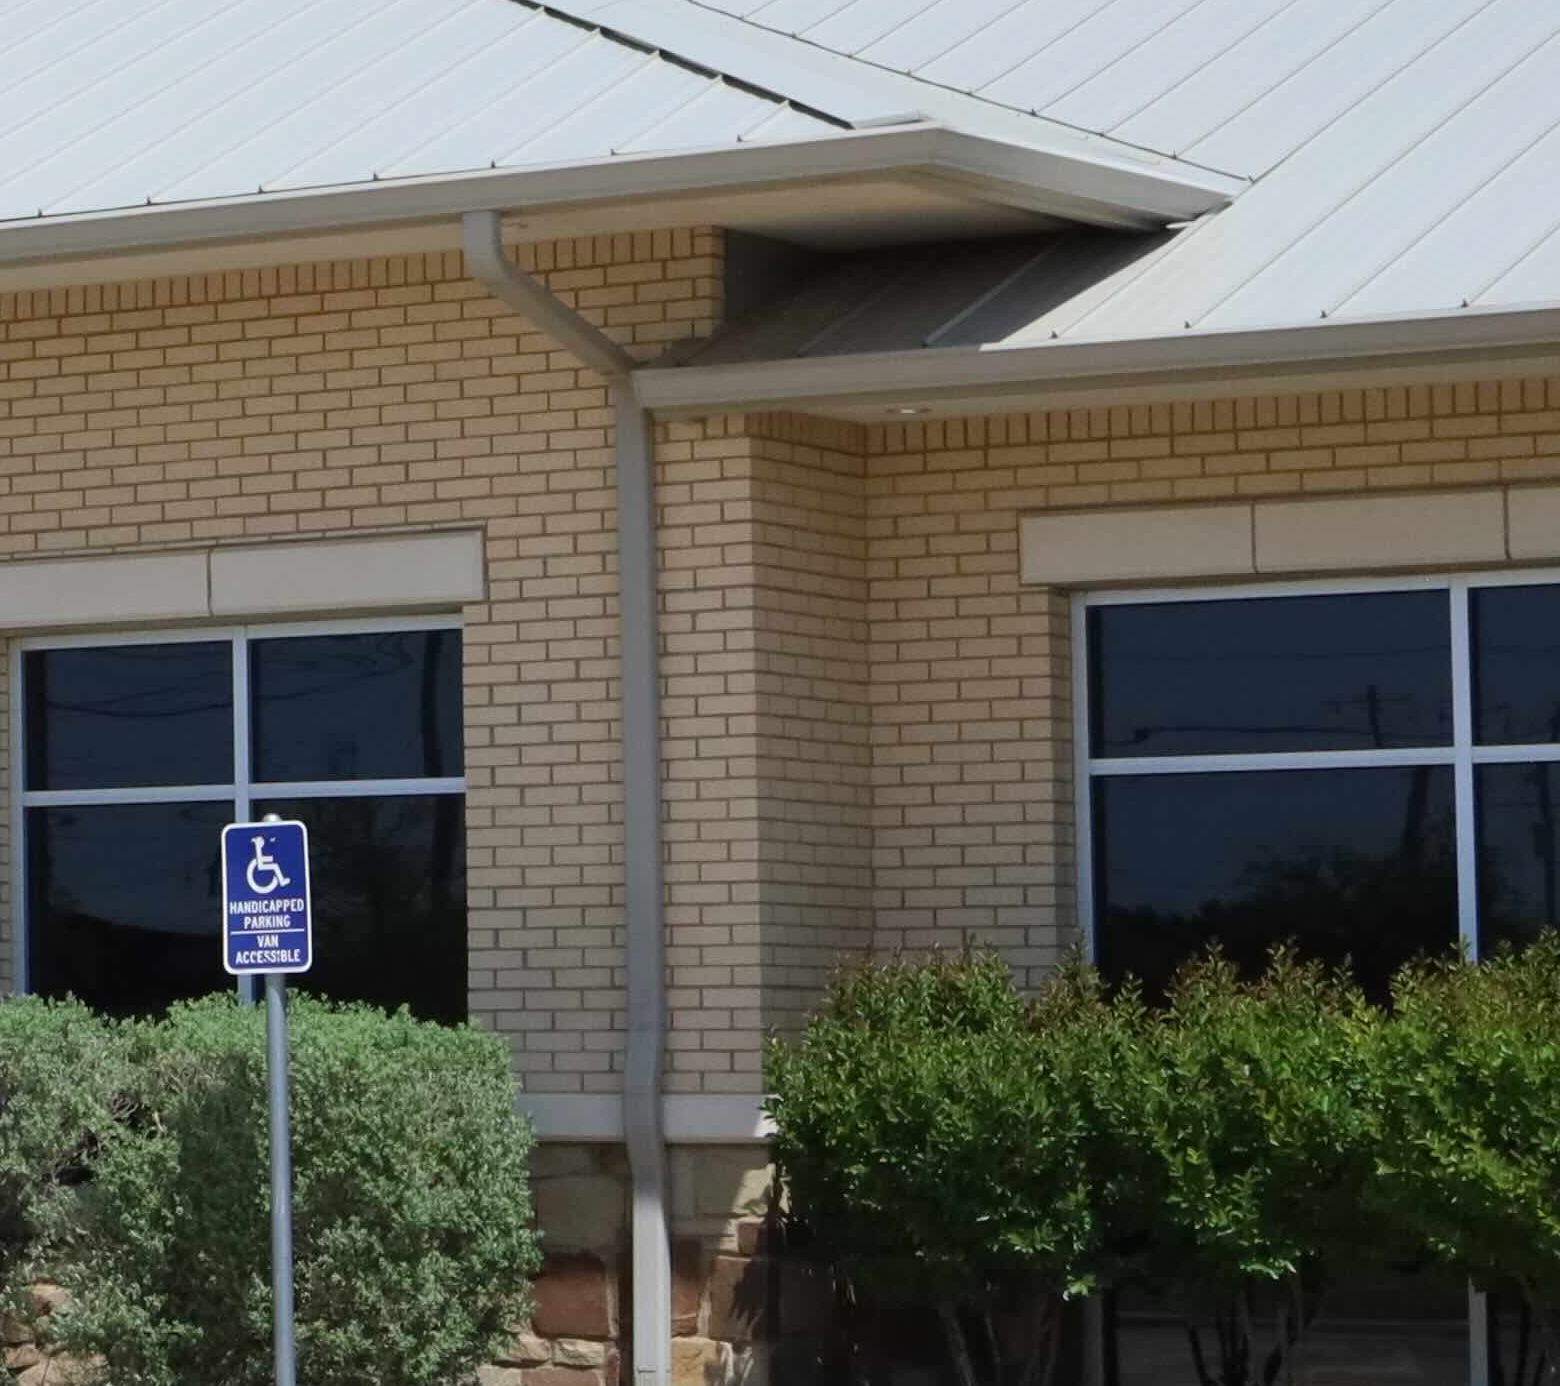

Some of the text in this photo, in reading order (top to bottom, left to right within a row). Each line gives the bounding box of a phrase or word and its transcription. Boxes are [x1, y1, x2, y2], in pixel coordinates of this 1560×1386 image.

[229, 898, 305, 915] HANDICAPPED
[243, 915, 291, 930] PARKING
[256, 935, 279, 948] VAN
[235, 949, 301, 965] ACCESSIBLE
